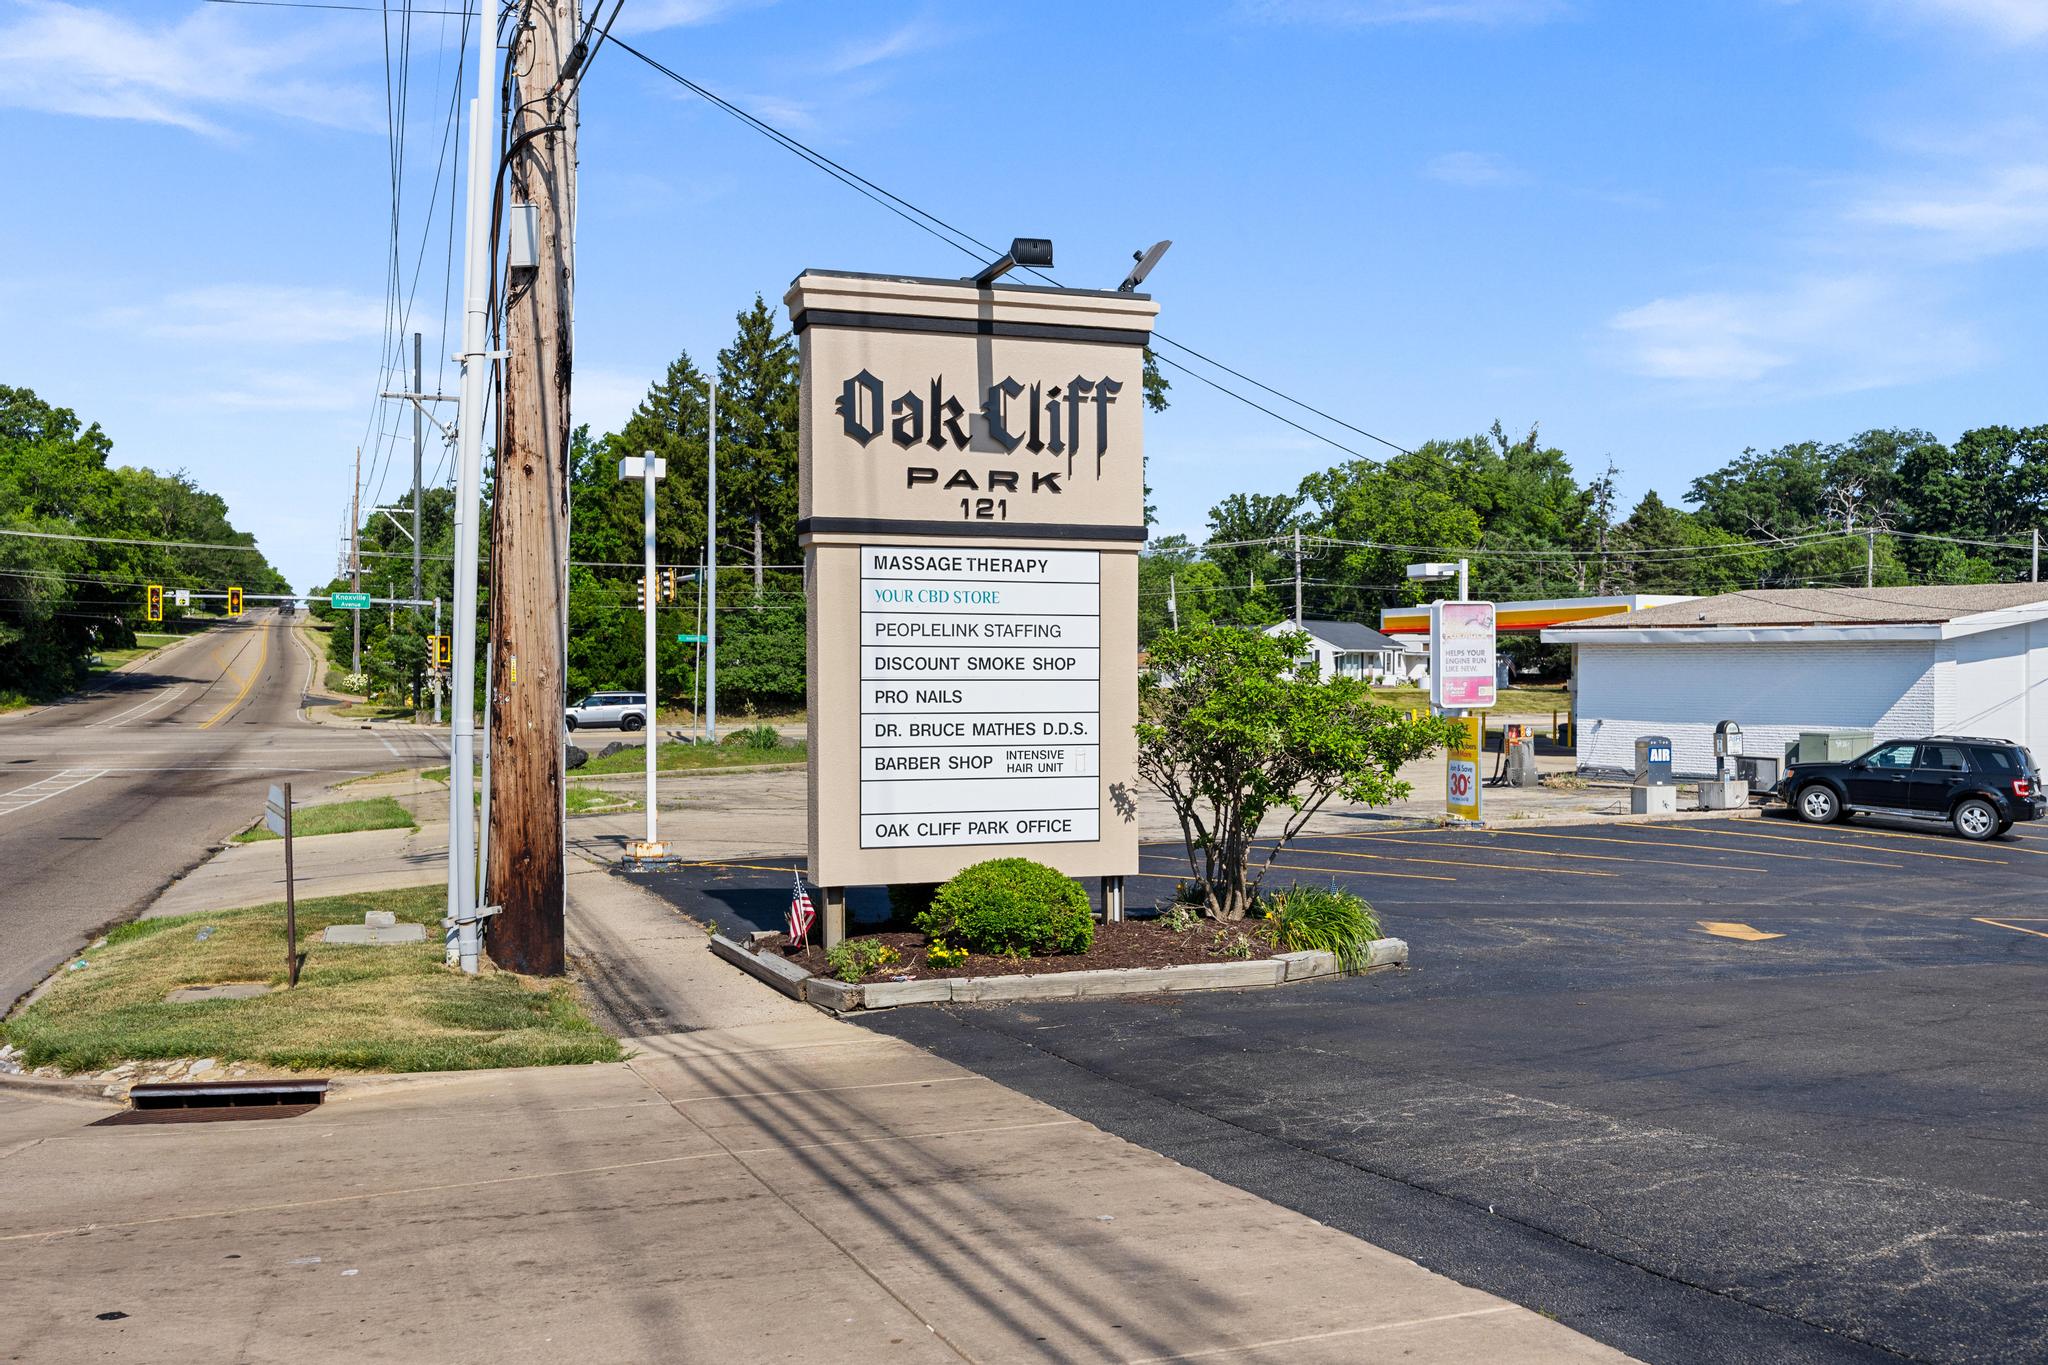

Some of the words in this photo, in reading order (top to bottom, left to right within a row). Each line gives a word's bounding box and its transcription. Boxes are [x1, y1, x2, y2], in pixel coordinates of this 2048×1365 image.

[835, 368, 973, 451] Oak
[981, 374, 1124, 480] Cliff
[907, 466, 1062, 494] PARK
[960, 498, 1007, 520] 121
[873, 555, 962, 572] MASSAGE
[966, 557, 1049, 574] THERAPY
[874, 589, 914, 603] YOUR
[918, 589, 950, 604] CBD
[953, 591, 1000, 604] STORE
[875, 623, 980, 638] PEOPLELINK
[984, 624, 1062, 638] STAFFING
[875, 656, 960, 671] DISCOUNT
[967, 657, 1025, 671] SMOKE
[1032, 657, 1077, 671] SHOP
[875, 690, 909, 704] PRO
[917, 690, 963, 704] NAILS
[875, 723, 902, 737] DR.
[909, 723, 965, 737] BRUCE
[972, 722, 1036, 737] MATHES
[1043, 721, 1088, 736] D.D.S.
[1006, 749, 1065, 760] INTENSIVE
[1650, 749, 1670, 762] AIR
[875, 757, 941, 771] BARBER
[948, 756, 993, 770] SHOP
[1006, 763, 1033, 773] HAIR
[1038, 762, 1064, 773] UNIT
[1461, 765, 1473, 773] Save
[875, 823, 910, 838] OAK
[917, 822, 962, 837] CLIFF
[968, 821, 1009, 835] PARK
[1016, 819, 1072, 834] OFFICE
